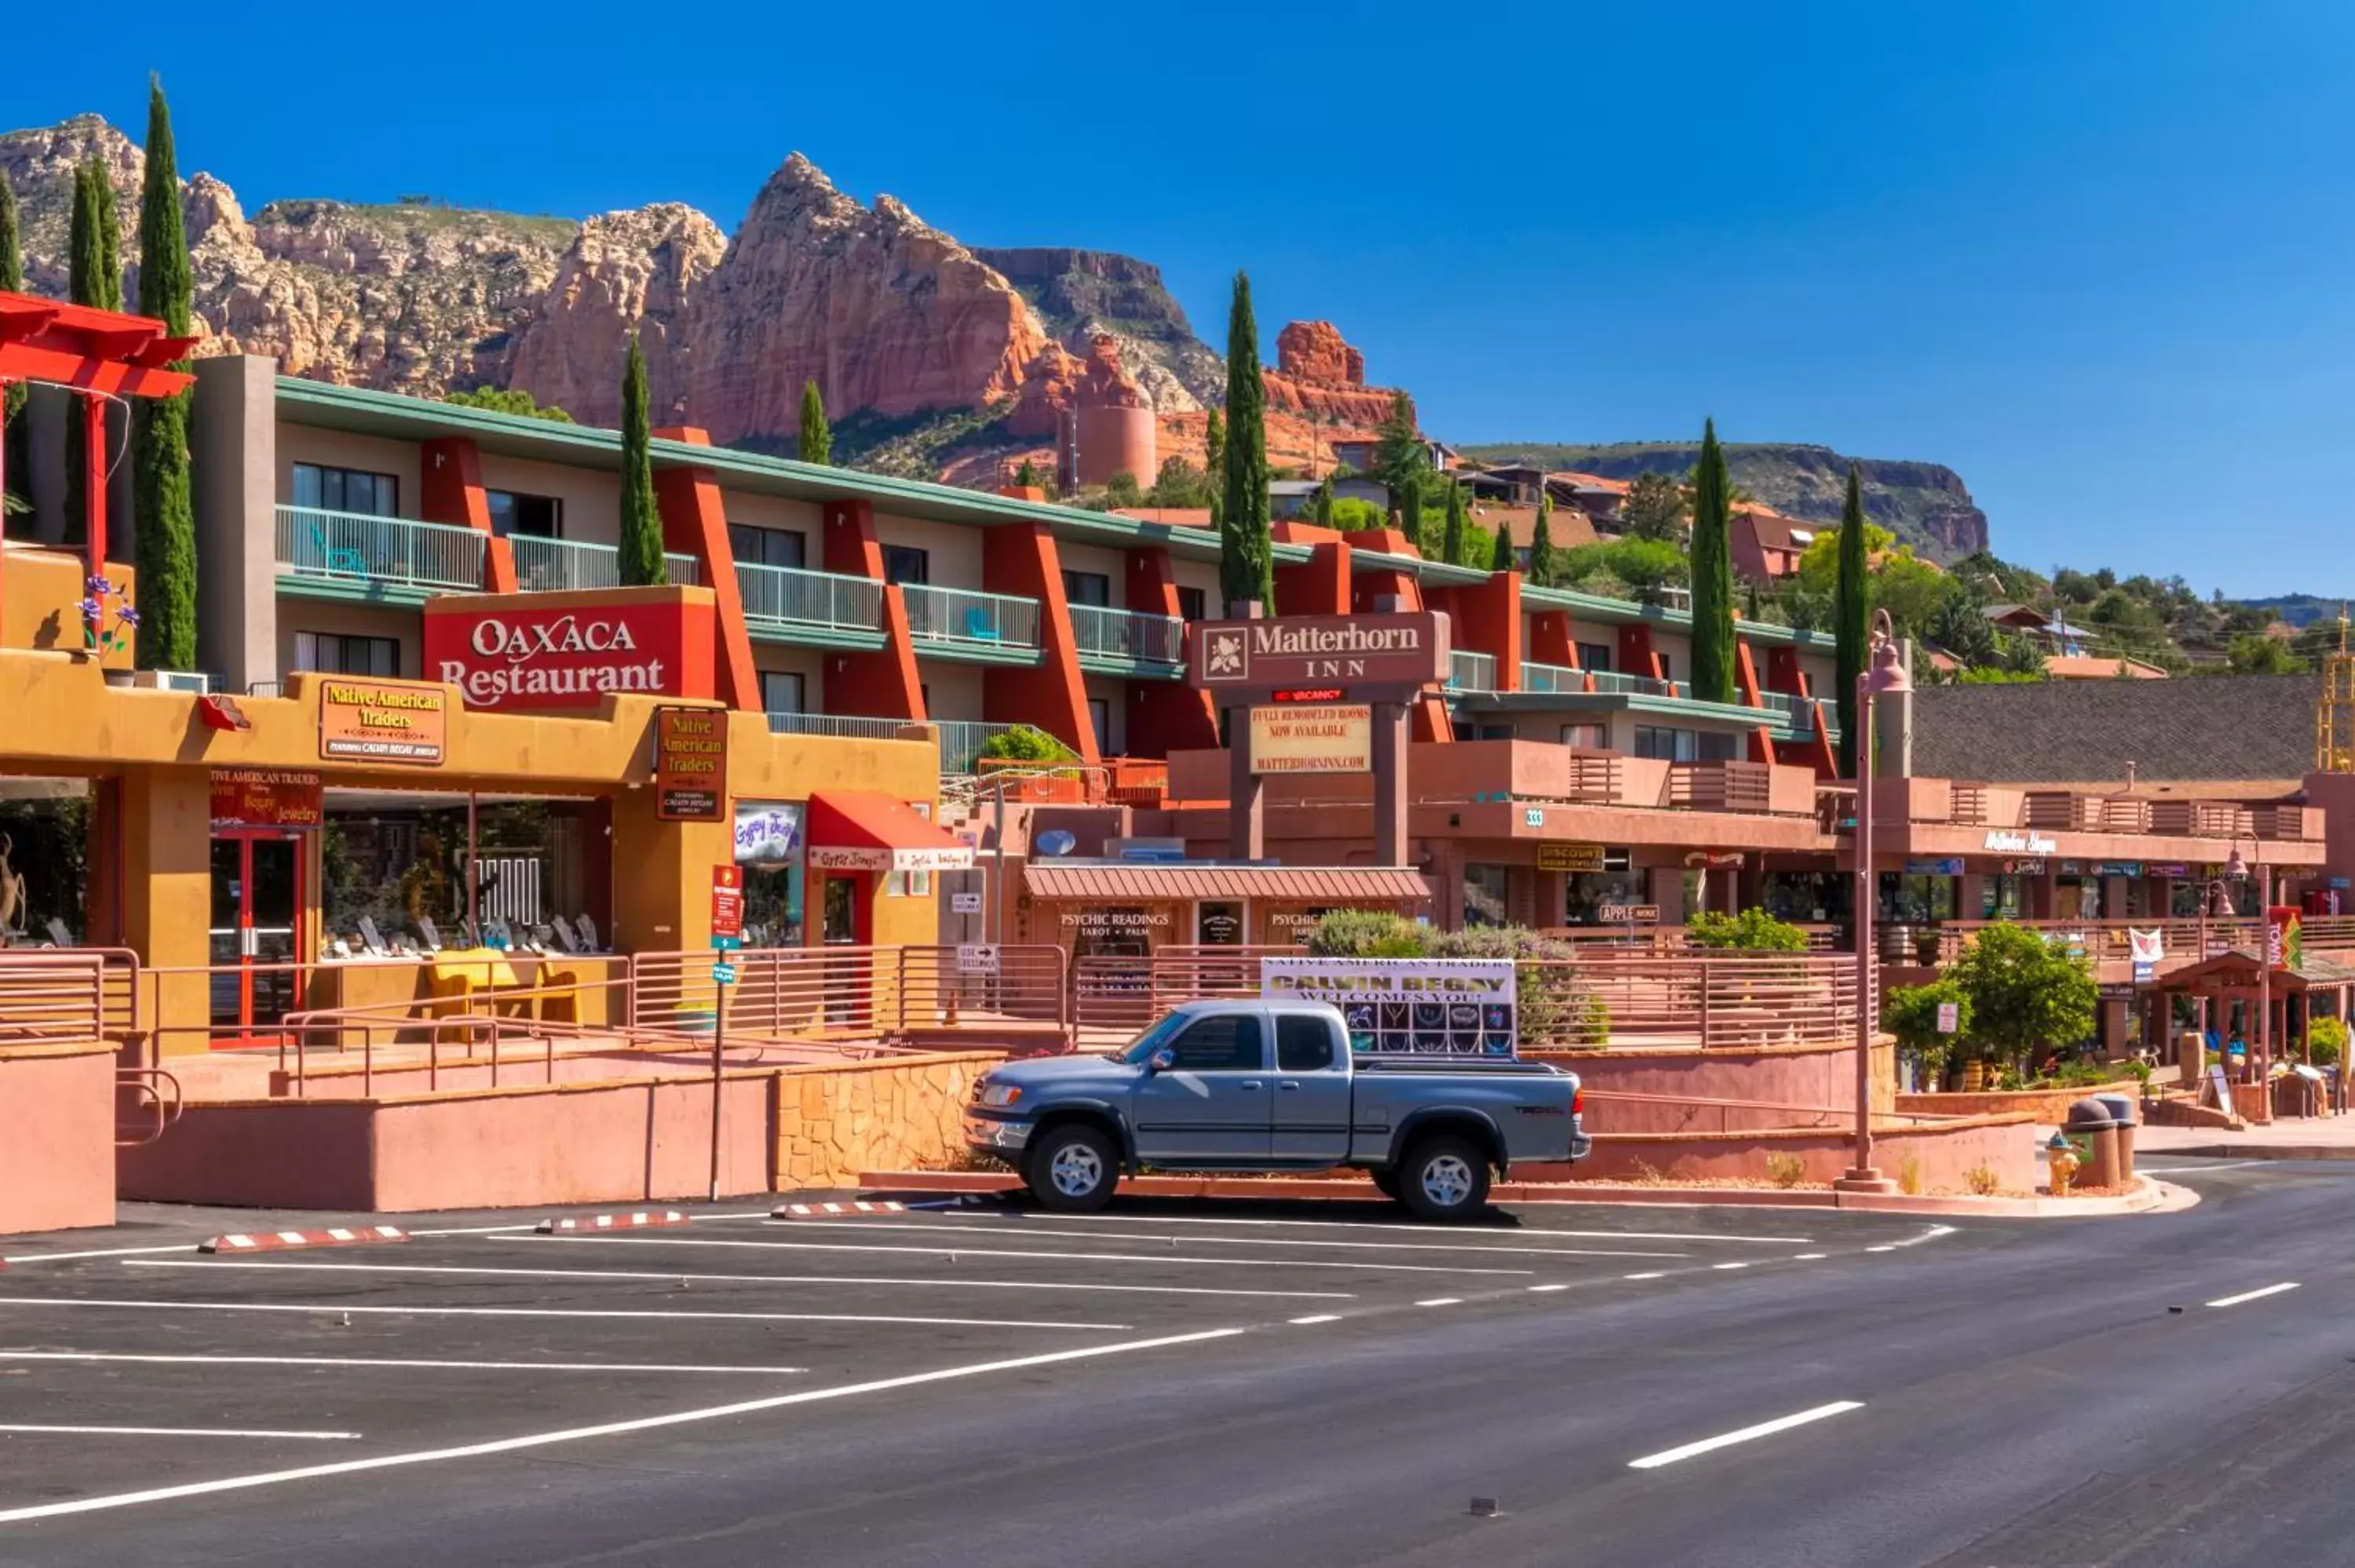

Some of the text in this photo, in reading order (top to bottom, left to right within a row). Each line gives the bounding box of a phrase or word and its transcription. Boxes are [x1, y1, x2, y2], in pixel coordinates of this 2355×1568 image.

[1254, 623, 1419, 655] Matterhorn
[1306, 660, 1365, 677] INN
[439, 657, 664, 706] Restaurant
[327, 685, 440, 711] Native American
[1293, 690, 1342, 701] VACANCY
[359, 708, 413, 727] Traders
[1252, 708, 1369, 722] FULLY REMODELED ROOMS
[673, 717, 712, 734] Native
[1269, 724, 1346, 737] NOW AVAILABLE
[664, 738, 721, 753] American
[668, 757, 714, 773] Traders
[1257, 756, 1364, 769] MATTERHORNINN.COM
[232, 771, 279, 783] AMERICAN
[283, 773, 319, 785] TRADERS
[1061, 914, 1169, 925] PSYCHIC READINGS
[1272, 914, 1319, 925] PSYCHIC
[1603, 907, 1634, 920] APPLE
[1082, 928, 1150, 936] TAROT PALM
[1271, 975, 1506, 993] CALVIN BEGAY
[1298, 992, 1482, 1004] WELCOMES YOU!
